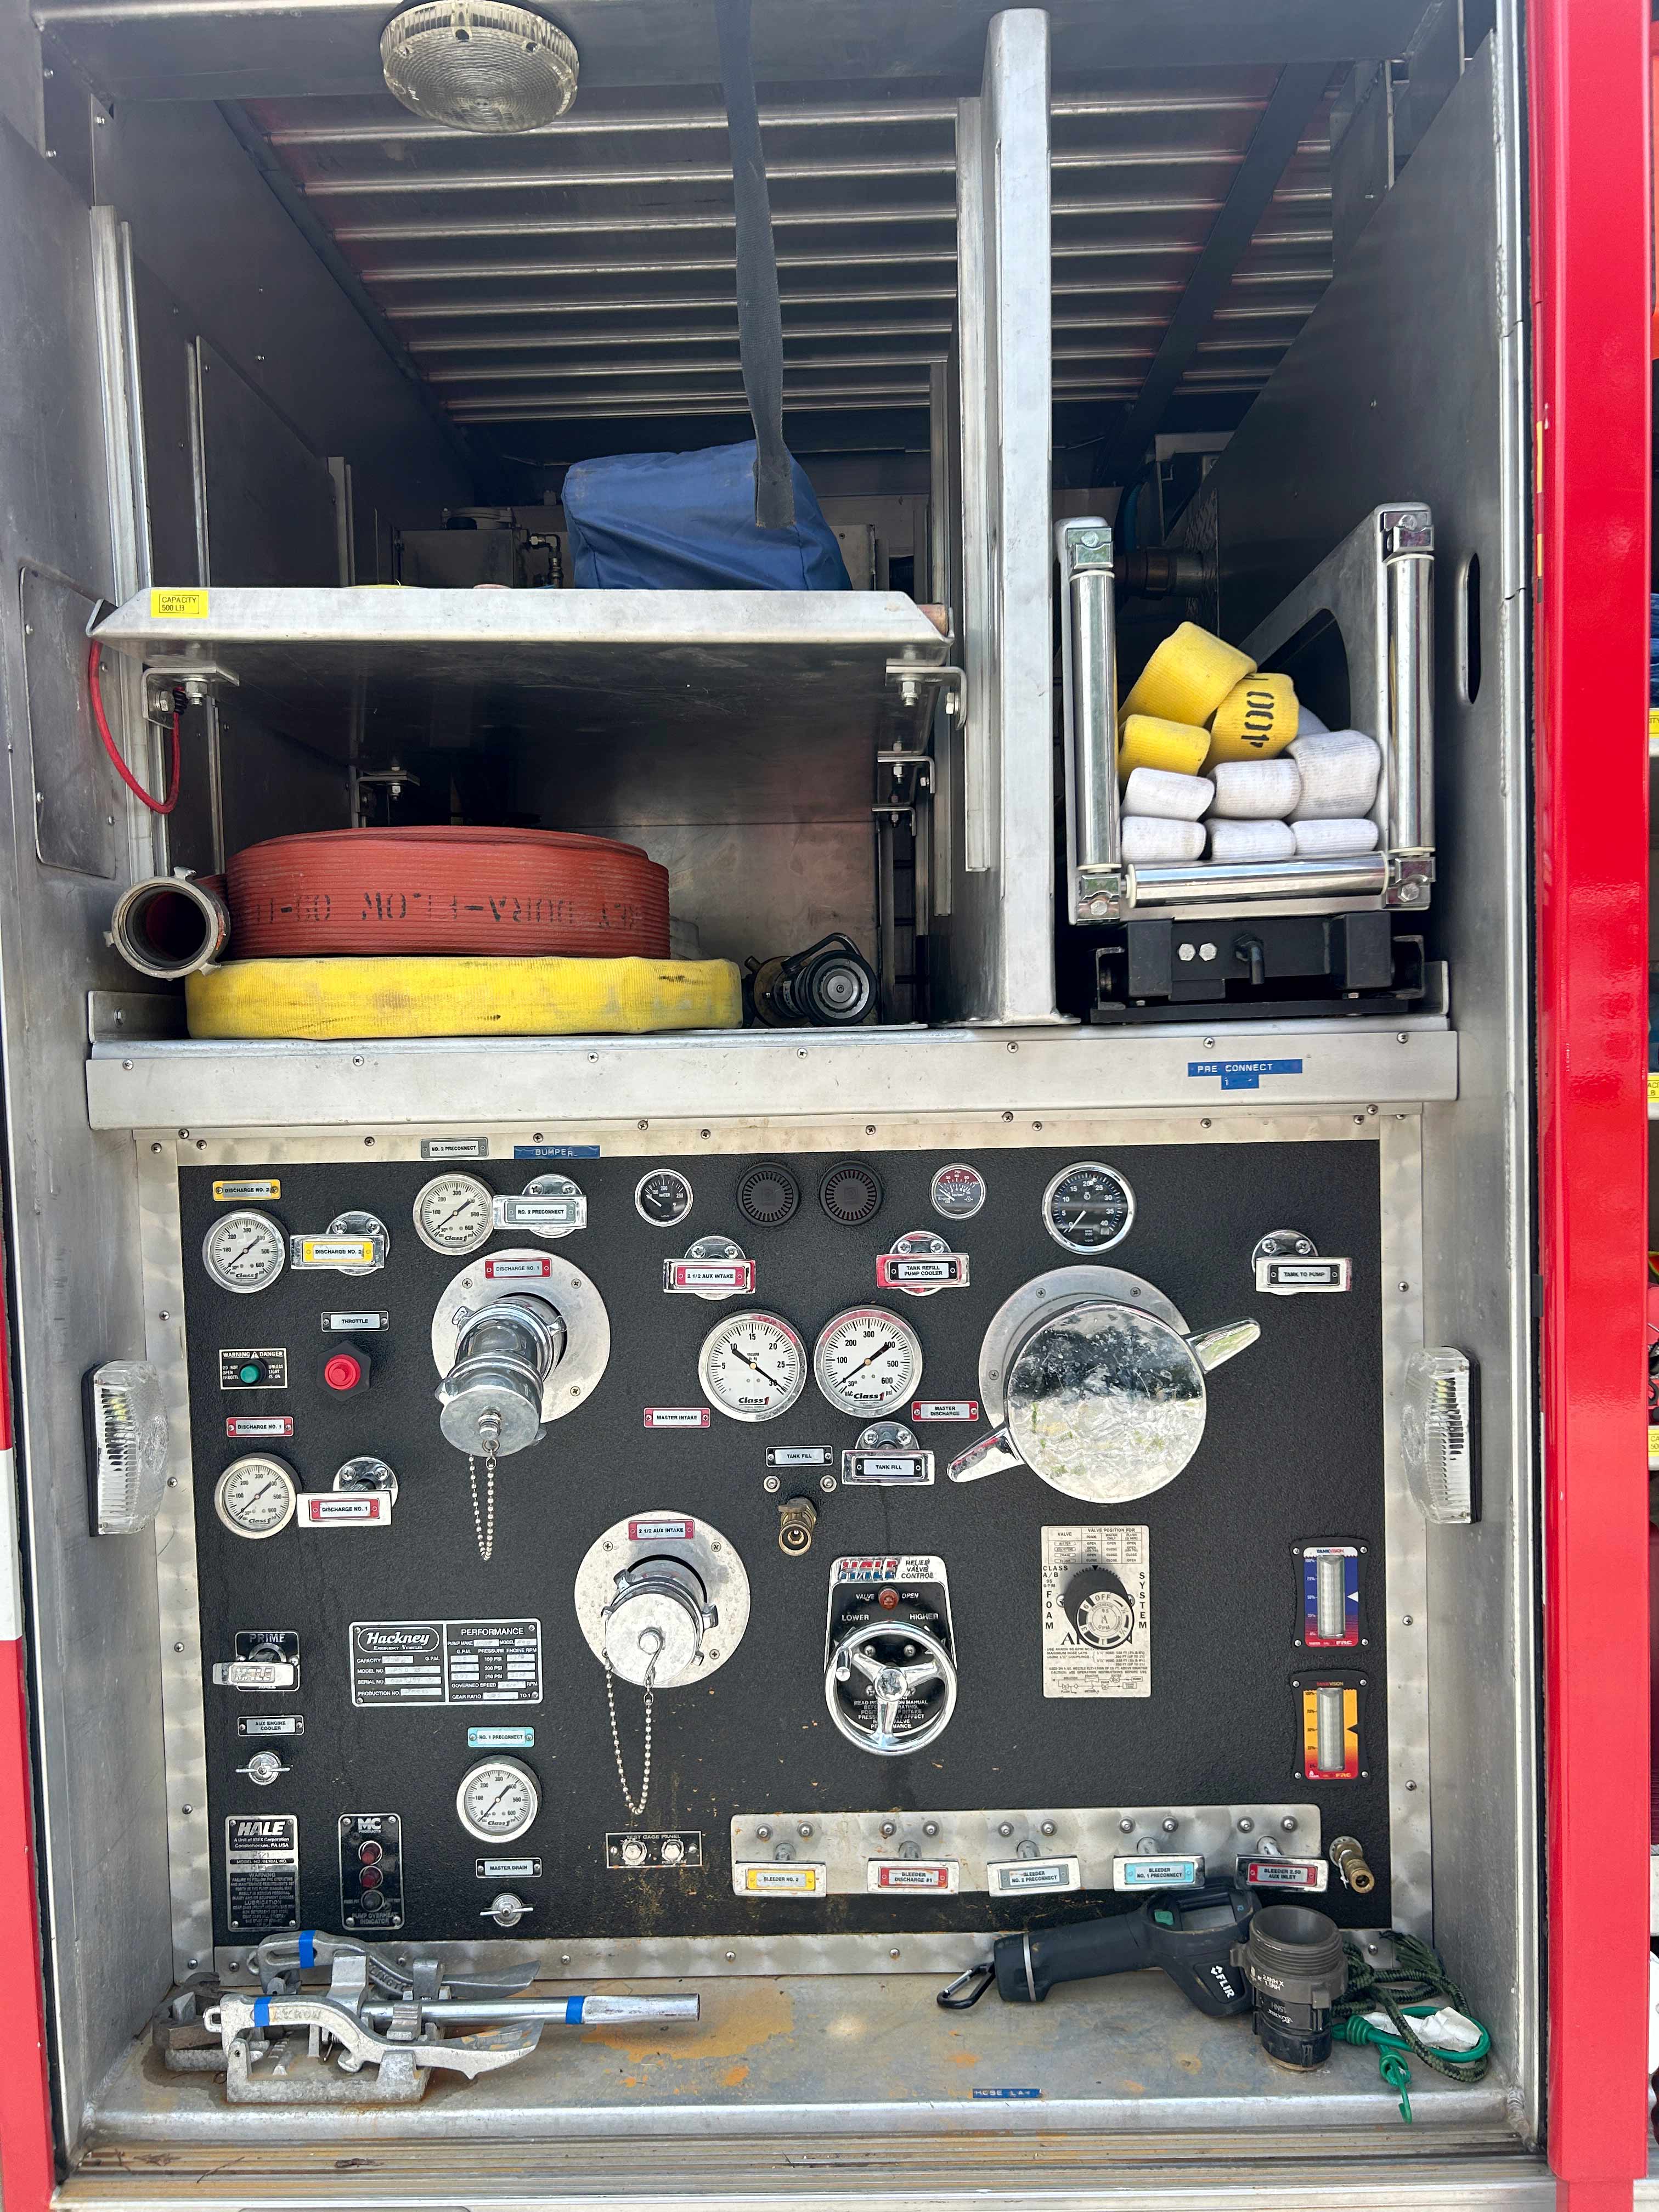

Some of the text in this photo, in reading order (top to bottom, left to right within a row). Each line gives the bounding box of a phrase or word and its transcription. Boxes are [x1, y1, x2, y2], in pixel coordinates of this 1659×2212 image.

[1225, 1064, 1273, 1072] CONNECT
[1139, 1572, 1147, 1629] SYSTEM
[249, 1633, 286, 1643] PRIME
[366, 1632, 430, 1646] Hackney
[461, 1628, 524, 1636] PERFORMANCE
[237, 1821, 285, 1836] HALE
[358, 1818, 381, 1830] MC
[1216, 1974, 1235, 1999] FLIR
[275, 2008, 321, 2022] AKRON
